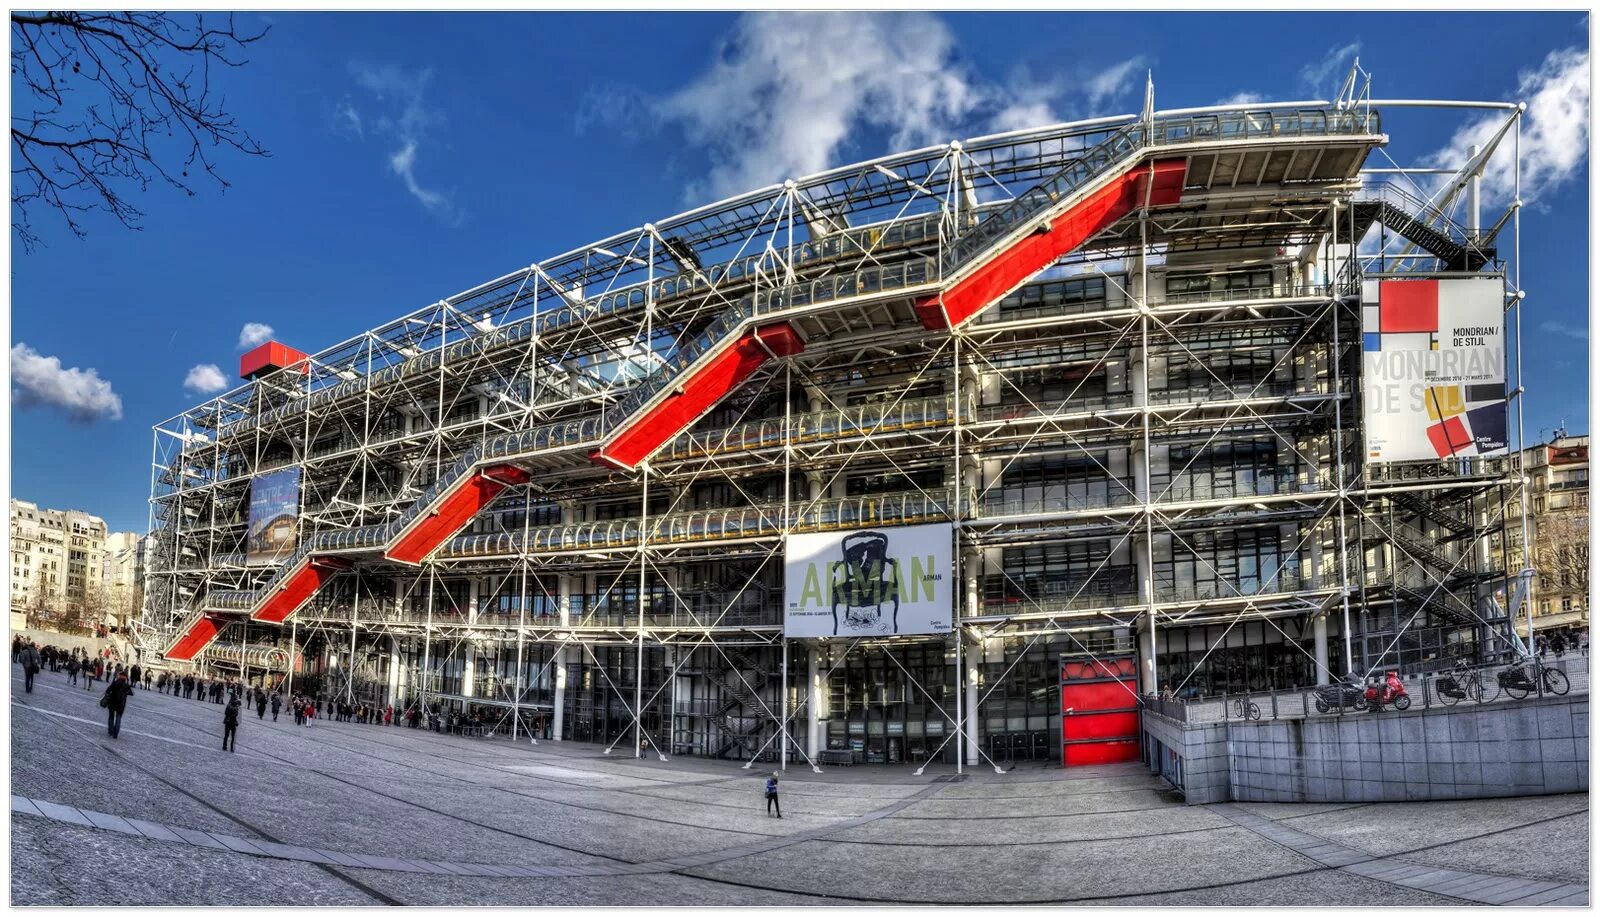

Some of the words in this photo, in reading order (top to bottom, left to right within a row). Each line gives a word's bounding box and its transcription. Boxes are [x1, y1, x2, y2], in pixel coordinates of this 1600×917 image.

[1453, 327, 1494, 337] MONDRIAN
[1453, 337, 1463, 347] DE
[1465, 336, 1486, 347] STIJL
[1365, 347, 1501, 381] MONDRIAN
[800, 555, 936, 607] ARMAN
[923, 574, 942, 582] ARMAN
